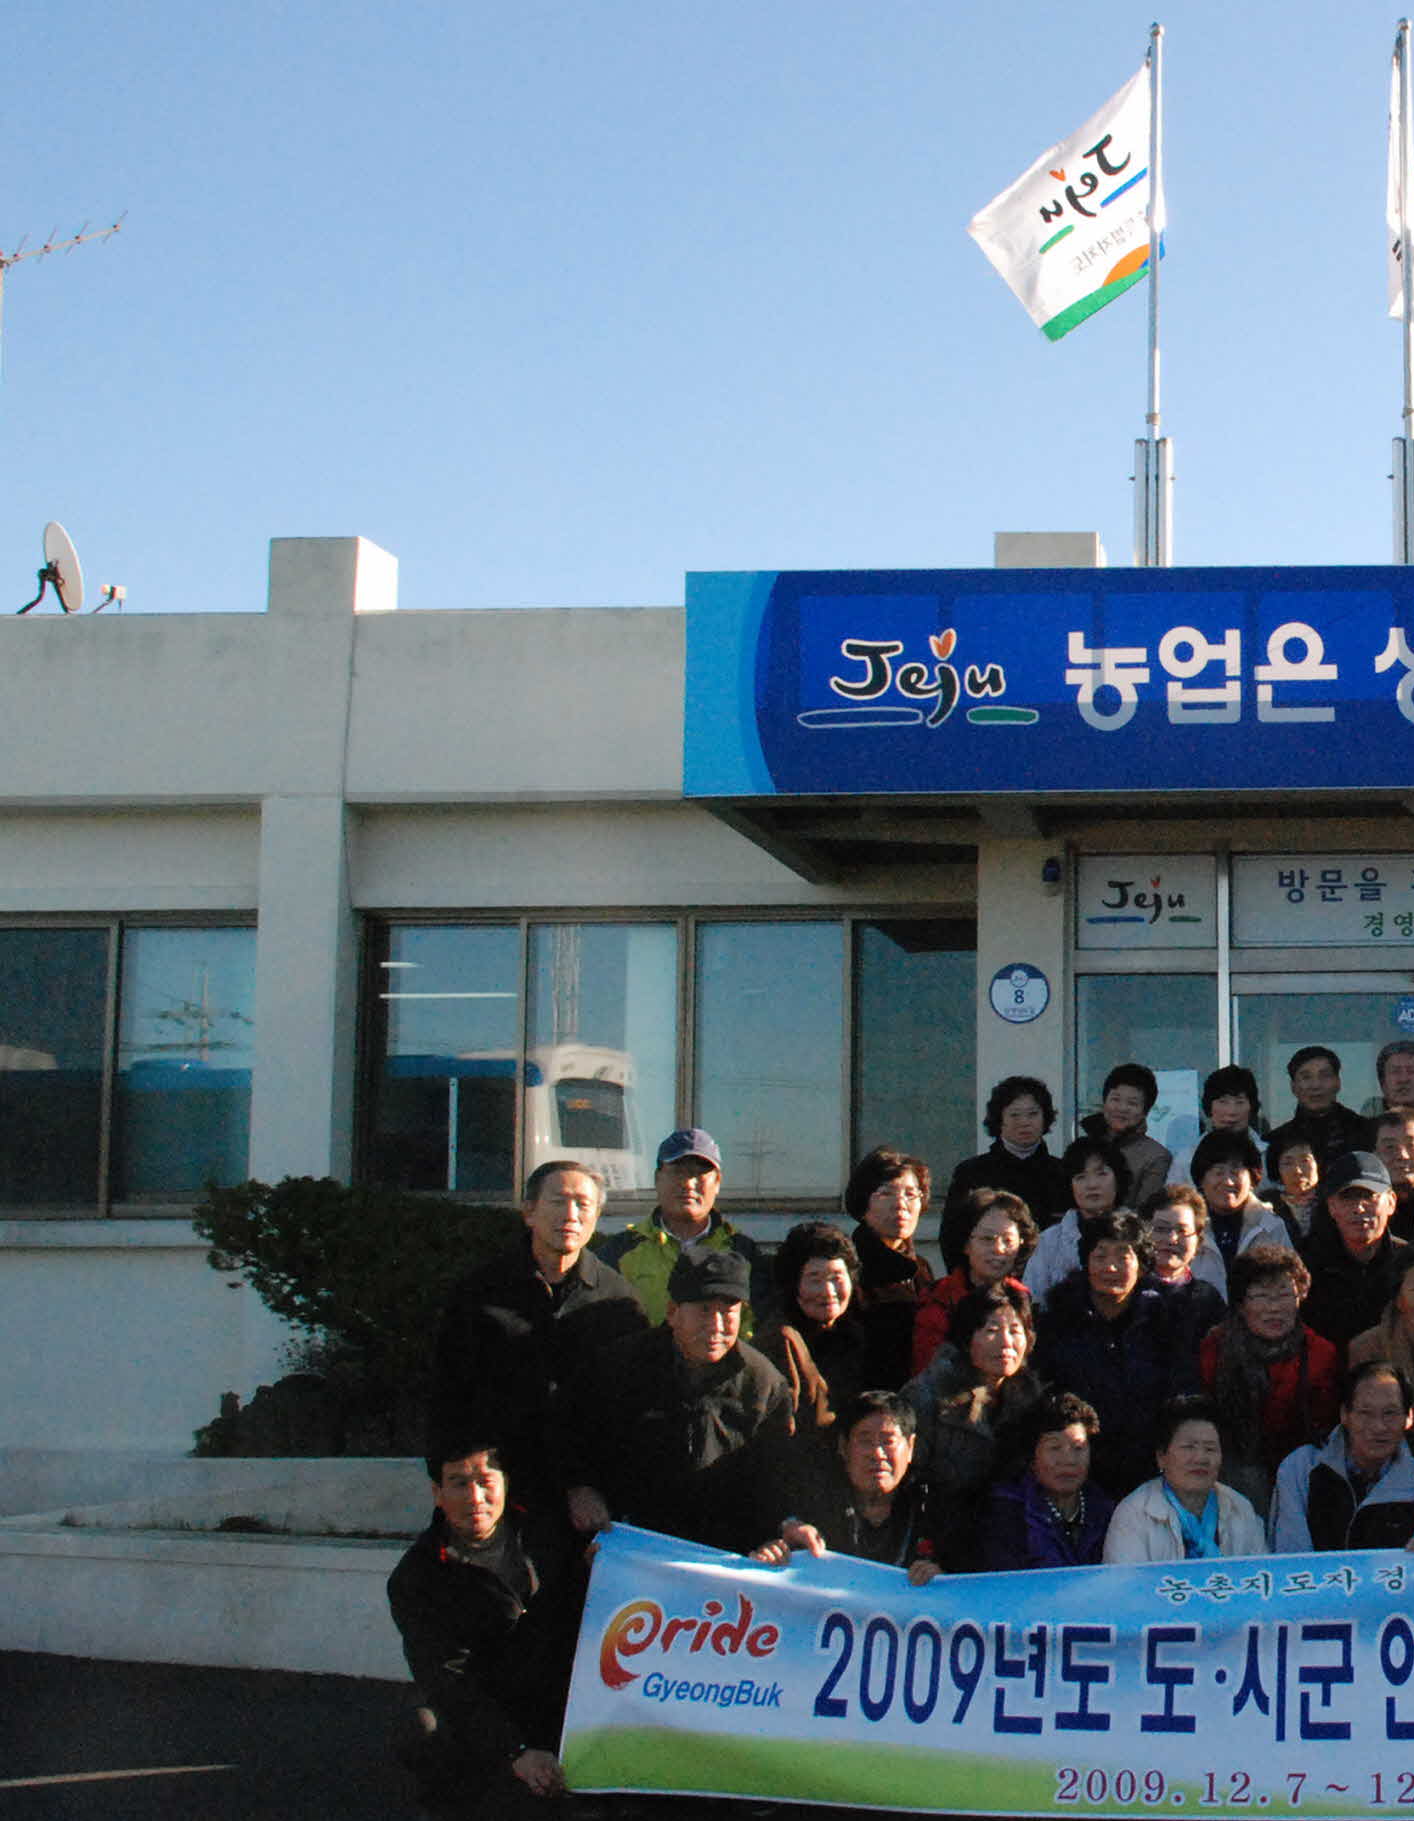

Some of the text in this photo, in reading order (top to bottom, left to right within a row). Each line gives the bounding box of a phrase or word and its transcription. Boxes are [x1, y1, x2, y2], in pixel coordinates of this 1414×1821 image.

[830, 629, 1006, 728] Jeju
[1064, 621, 1338, 731] 농업은
[1101, 876, 1186, 924] Jeju
[1278, 867, 1387, 903] 방문을
[1014, 989, 1025, 1004] 8
[1159, 1567, 1359, 1601] 농촌지도자
[600, 1592, 779, 1690] Pride
[643, 1672, 784, 1707] GyeongBuk
[813, 1612, 1111, 1734] 2009년도
